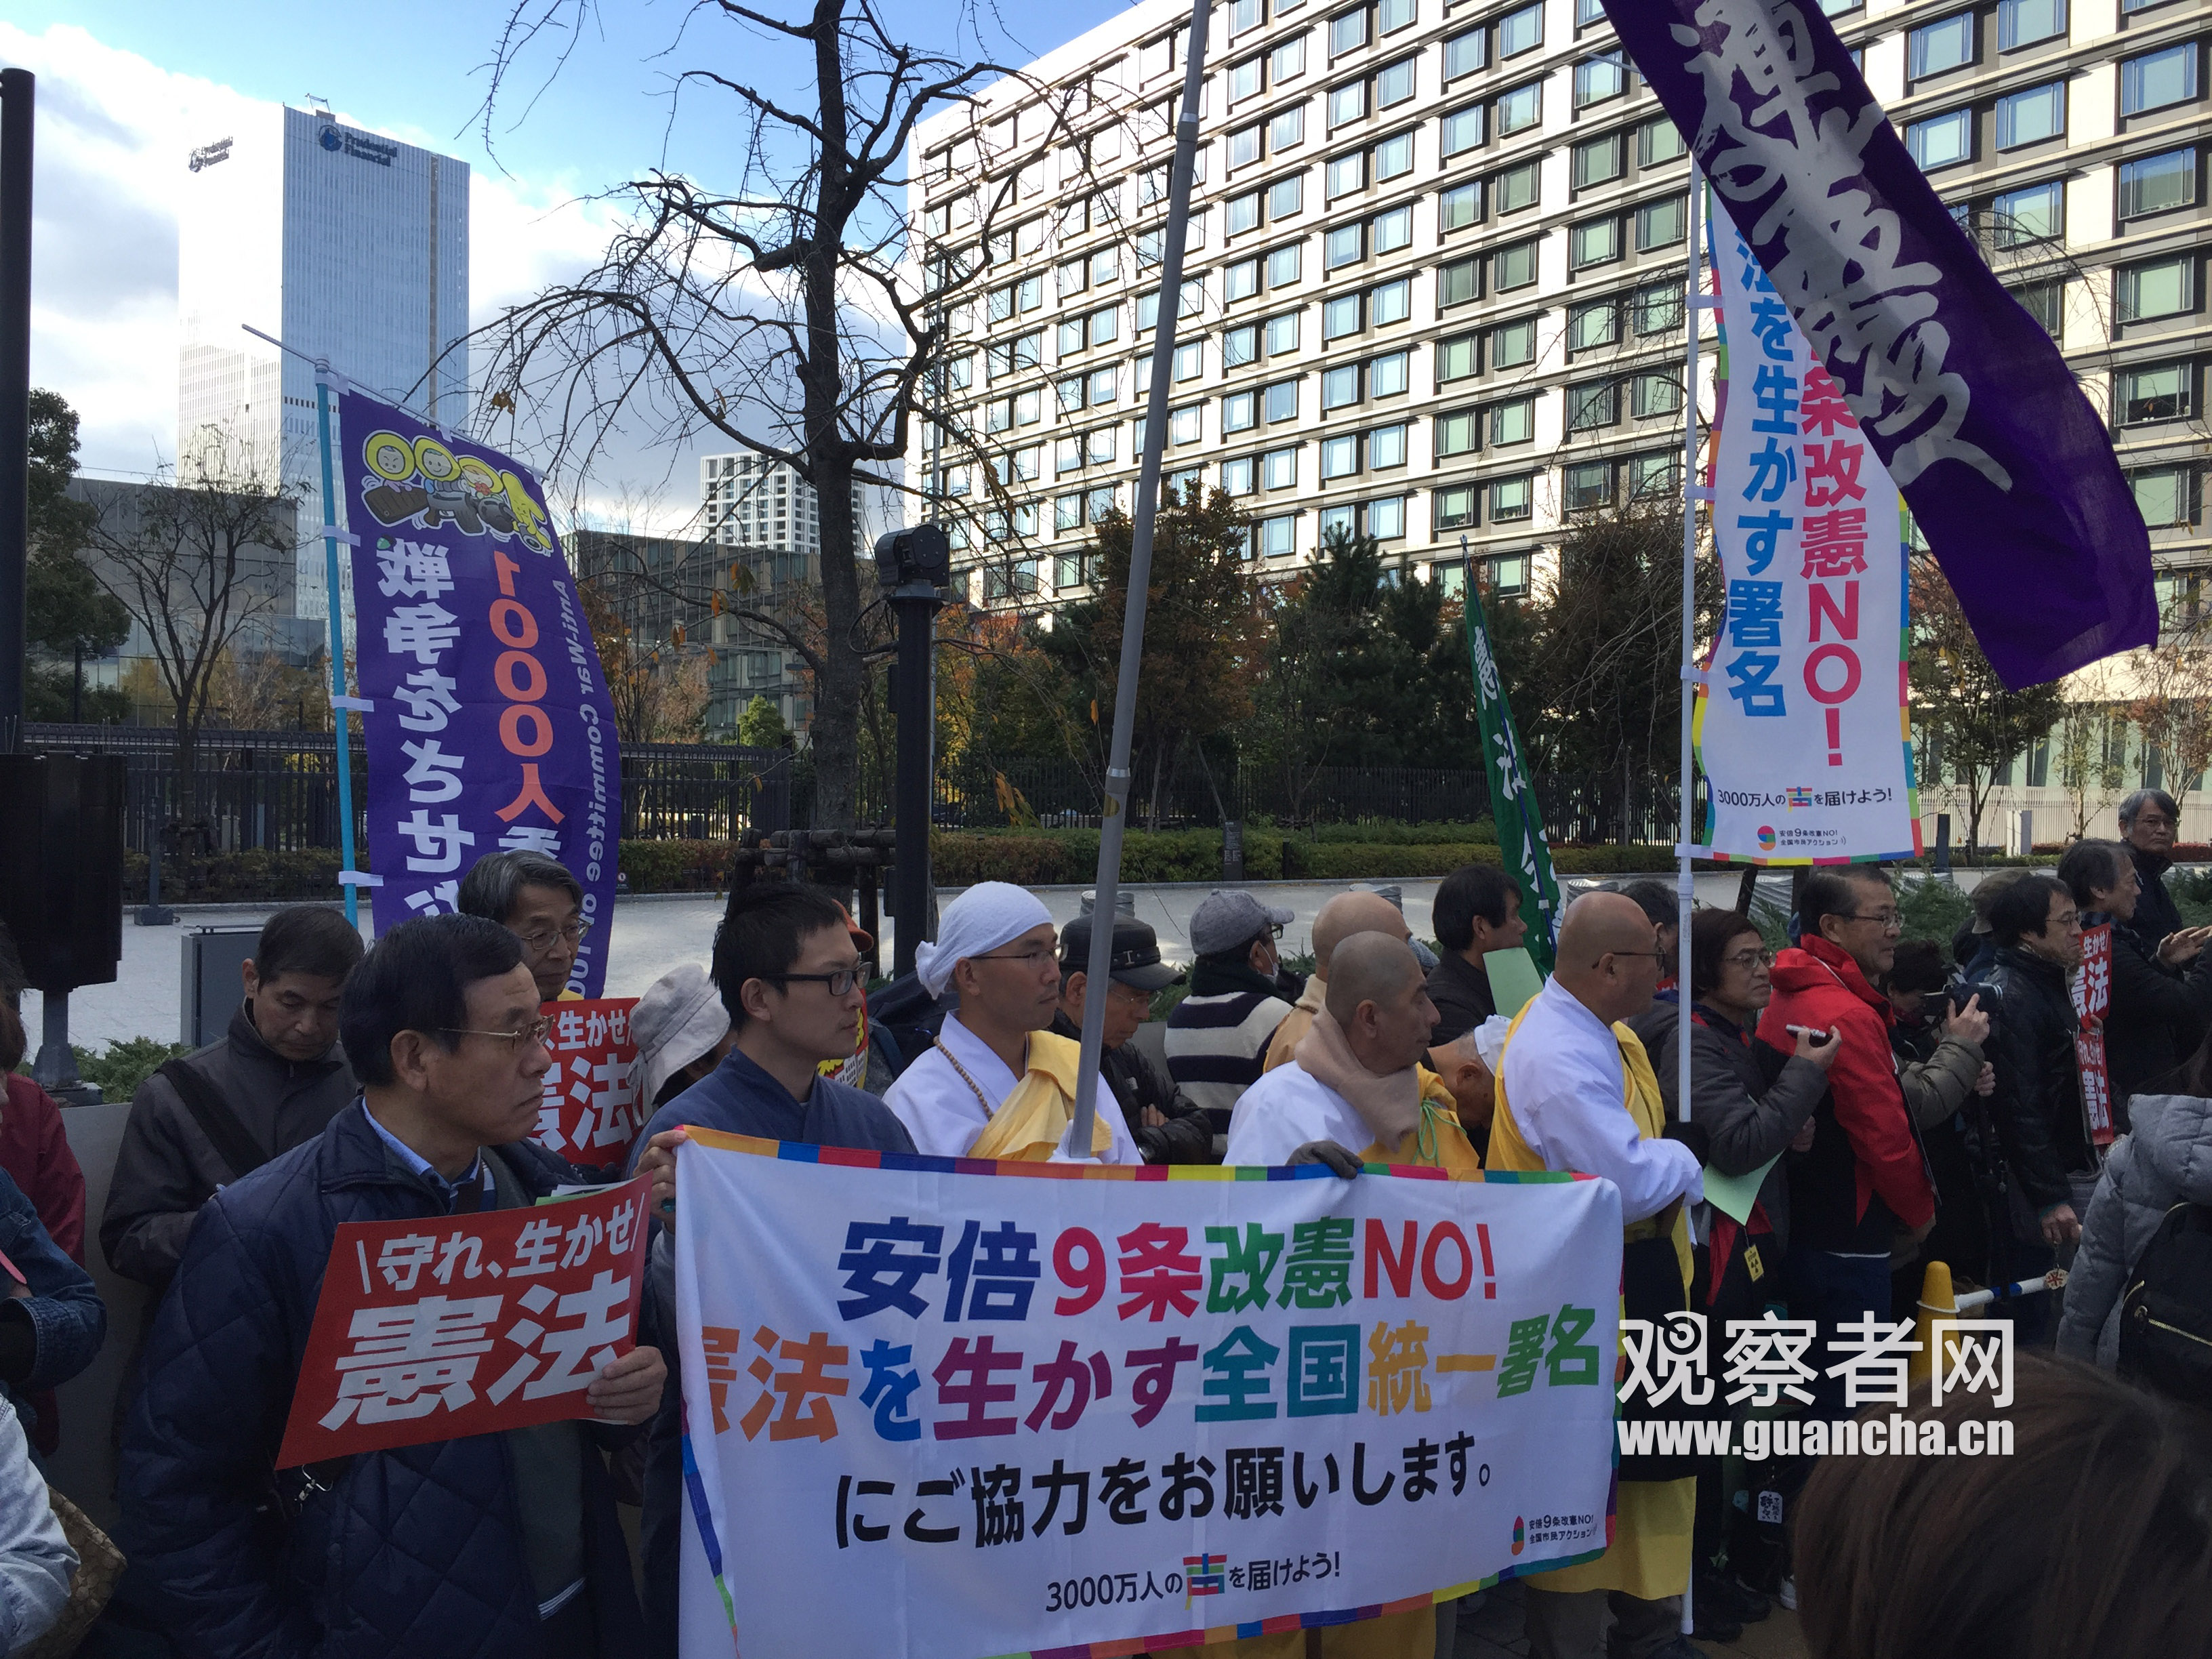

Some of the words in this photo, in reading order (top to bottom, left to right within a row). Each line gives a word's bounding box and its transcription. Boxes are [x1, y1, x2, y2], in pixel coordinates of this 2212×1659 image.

[1800, 346, 1869, 767] 条改憲NO!
[836, 1215, 1496, 1323] 安倍9条改憲NO!
[318, 1268, 632, 1431] 憲法
[835, 1430, 1491, 1550] にご協力をお願いします。
[1044, 1551, 1341, 1612] 3000万人の声を届けよう!
